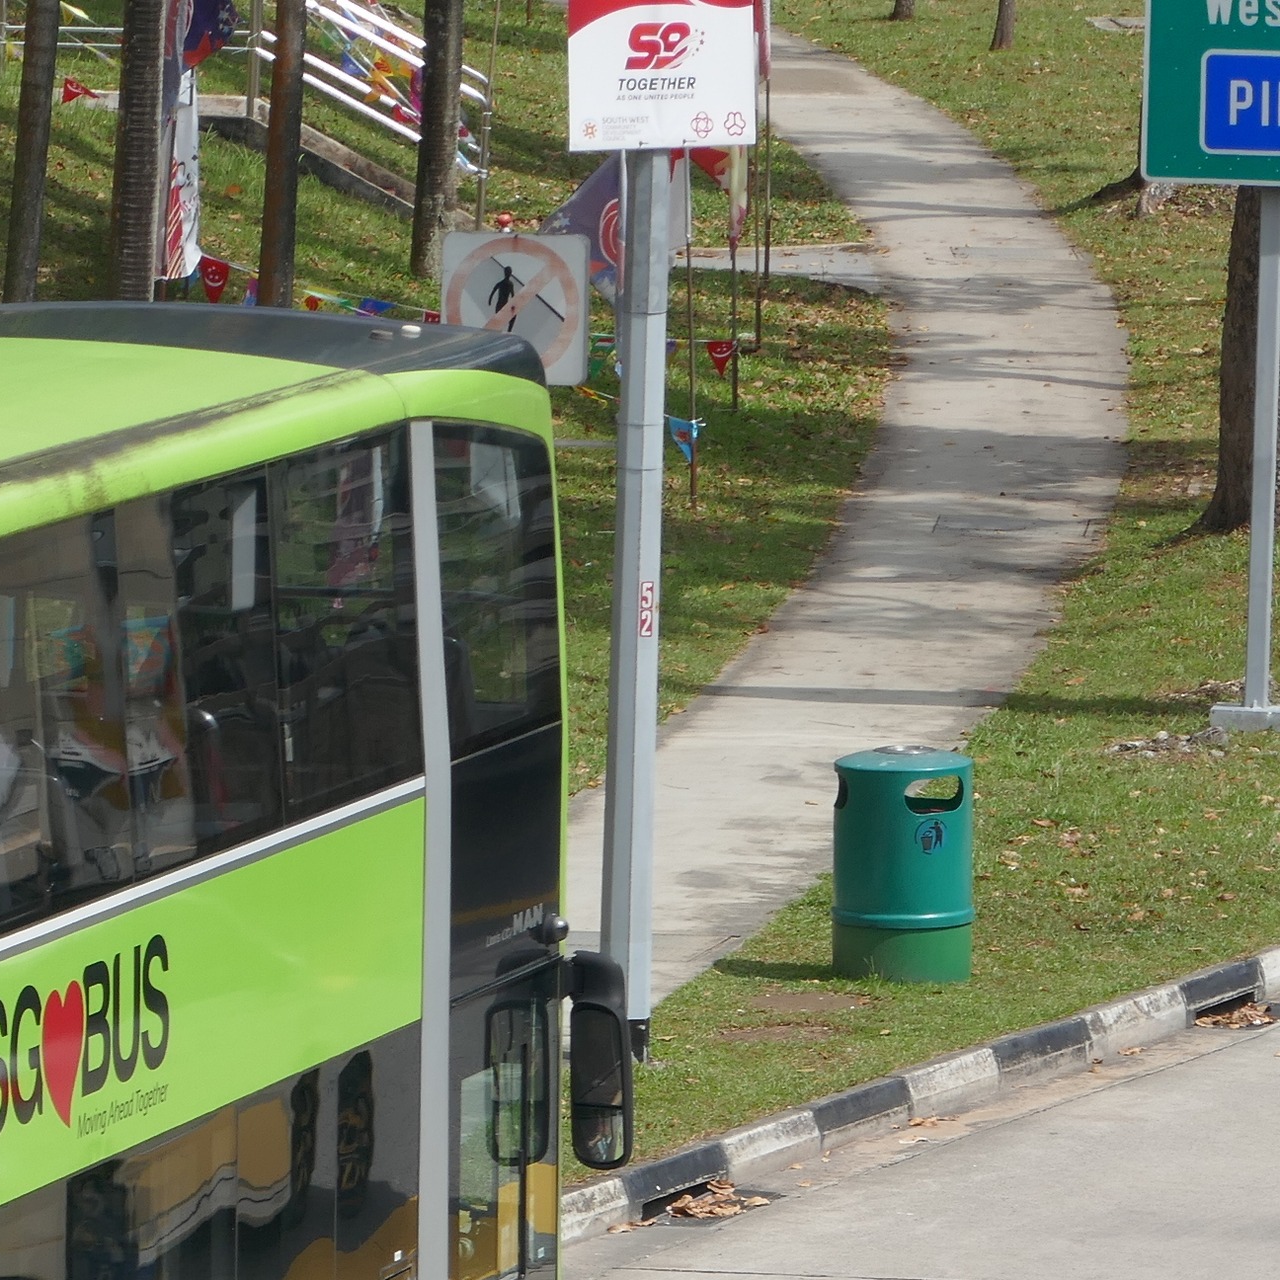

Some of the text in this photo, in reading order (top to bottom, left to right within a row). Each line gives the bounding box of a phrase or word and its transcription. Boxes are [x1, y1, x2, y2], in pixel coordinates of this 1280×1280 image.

[618, 77, 697, 91] TOGETHER
[670, 92, 695, 100] PEOPLE
[1228, 79, 1280, 127] PI
[602, 115, 650, 125] SOUTH WEST
[512, 903, 544, 936] MAN
[77, 1082, 169, 1139] Moving Ahead Together
